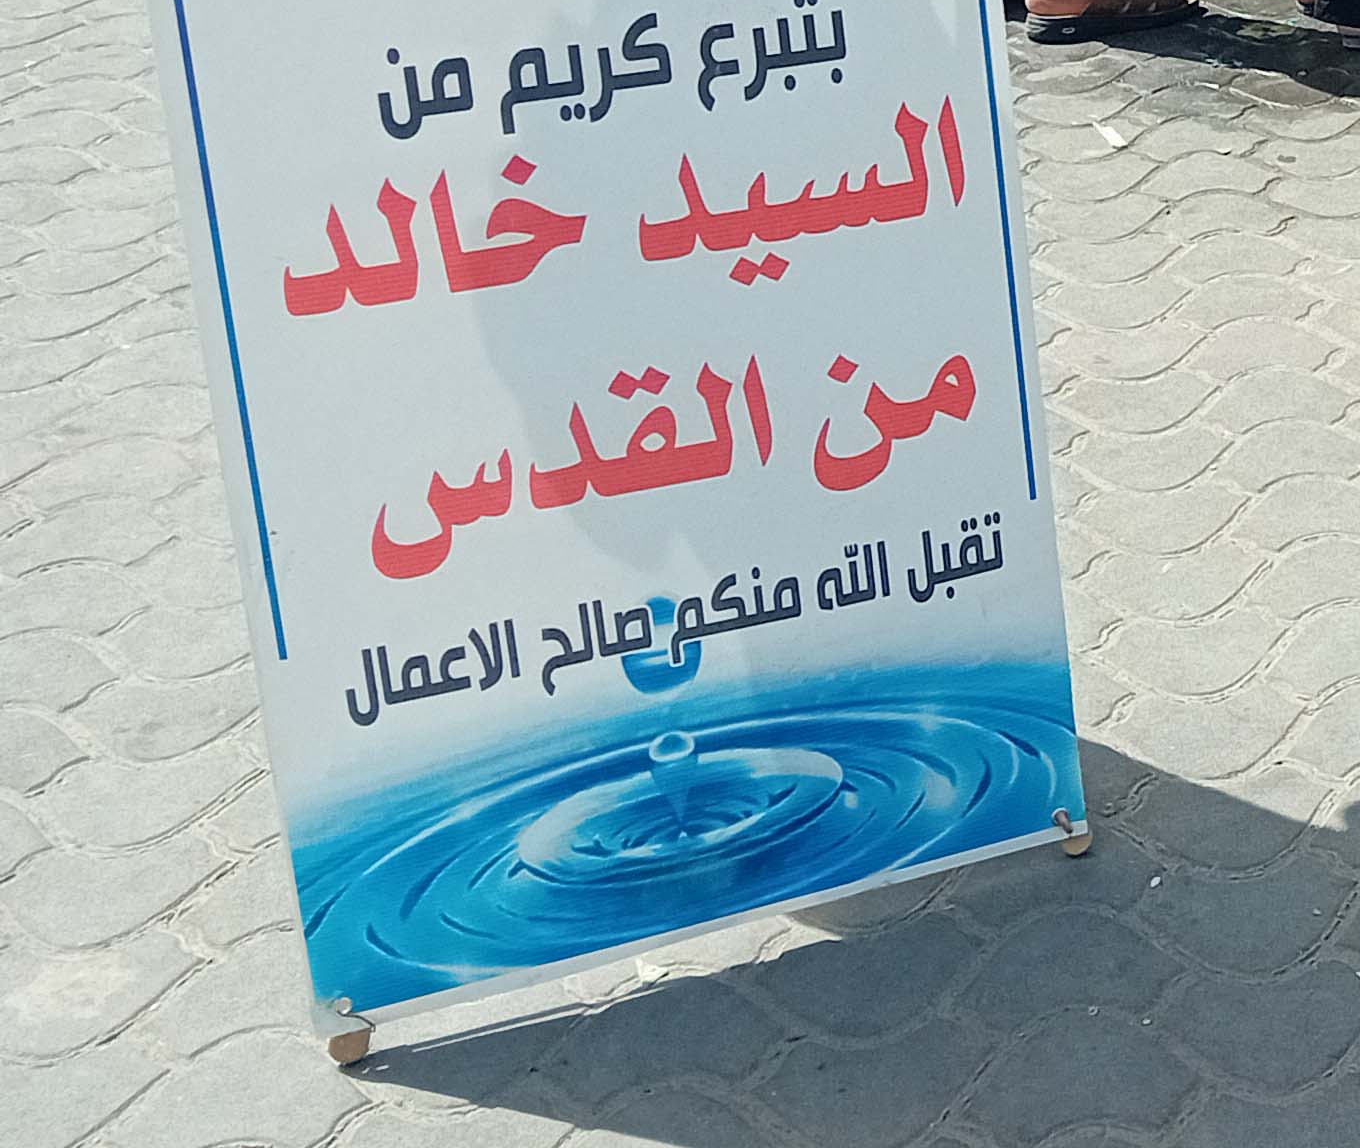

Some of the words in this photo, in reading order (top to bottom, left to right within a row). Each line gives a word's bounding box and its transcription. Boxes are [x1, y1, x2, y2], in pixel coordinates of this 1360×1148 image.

[378, 49, 473, 139] من
[501, 13, 672, 134] كريم
[283, 153, 587, 317] خالد
[637, 94, 966, 286] السيد
[371, 354, 773, 580] القدس
[813, 352, 978, 492] من
[670, 565, 800, 663] منكم
[907, 512, 1003, 602] تقبل
[346, 619, 520, 726] الاعمال
[541, 598, 652, 696] صالح
